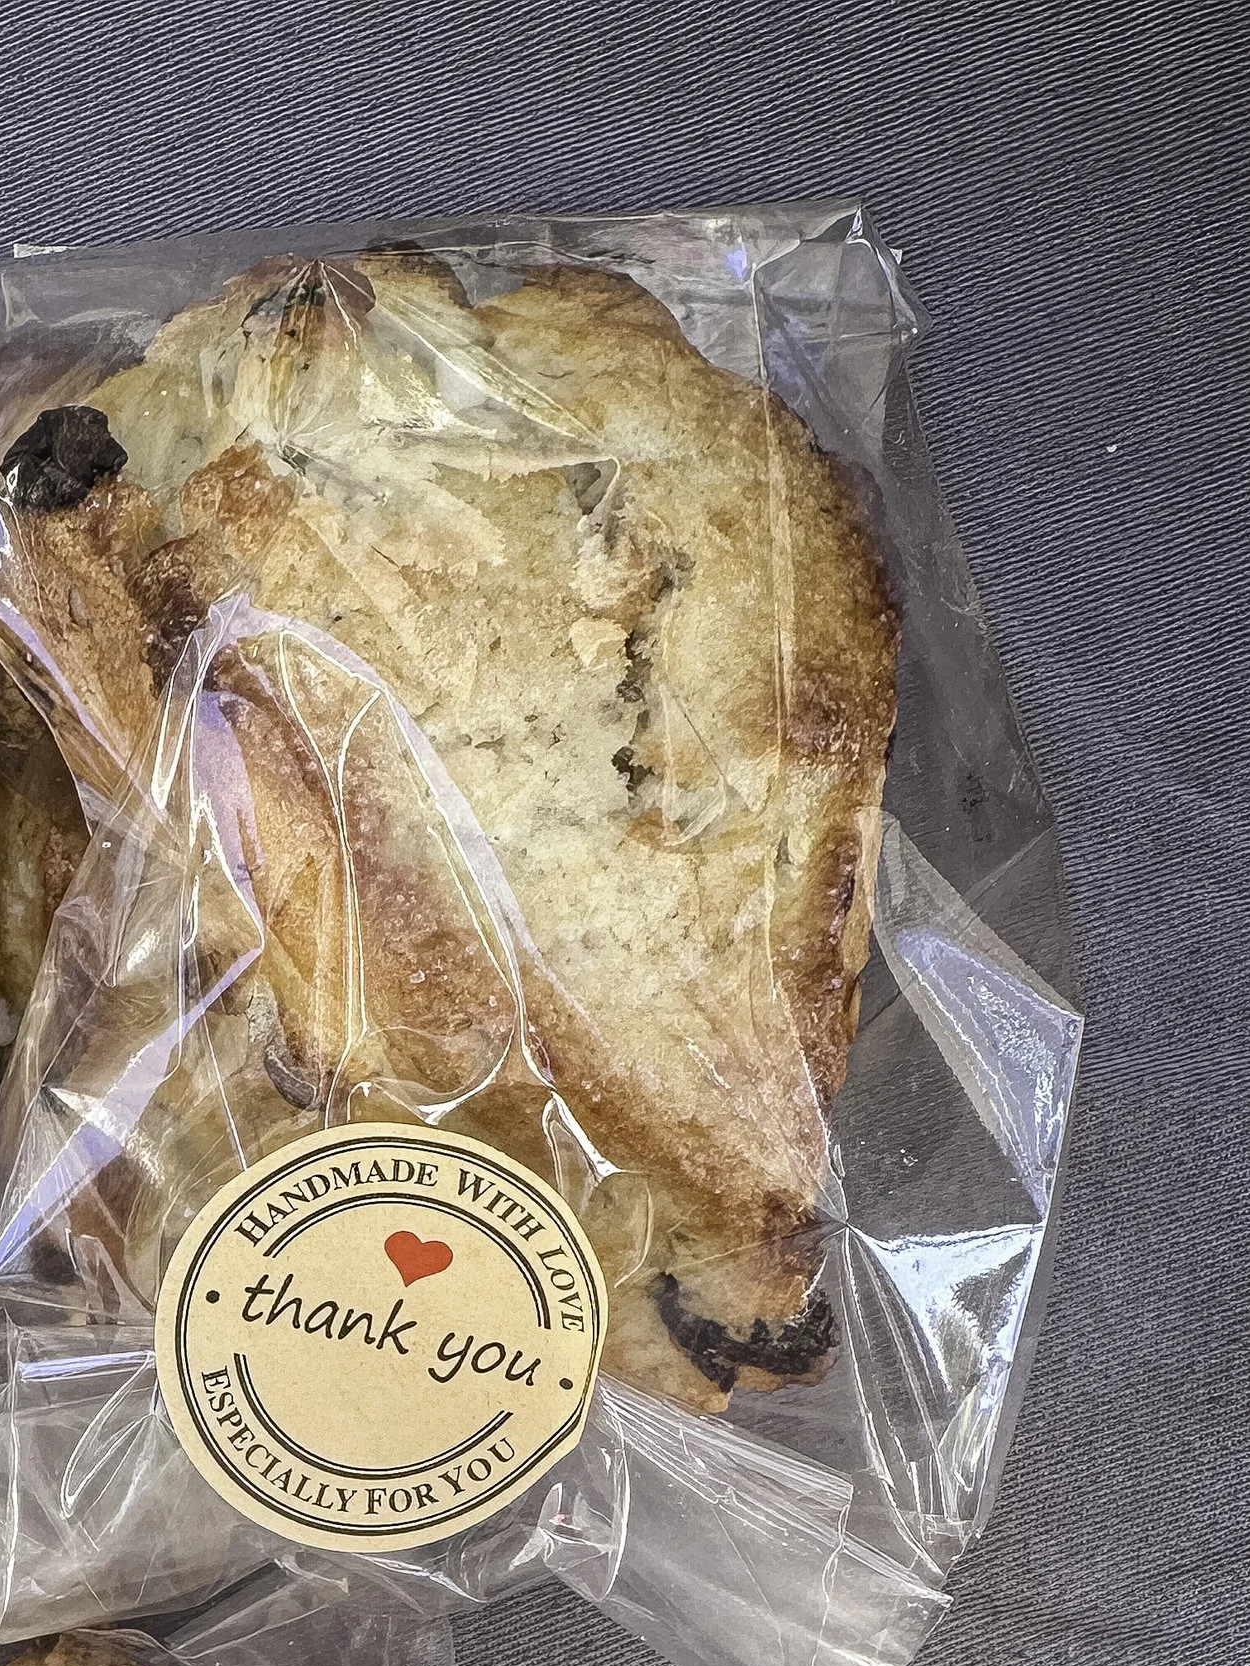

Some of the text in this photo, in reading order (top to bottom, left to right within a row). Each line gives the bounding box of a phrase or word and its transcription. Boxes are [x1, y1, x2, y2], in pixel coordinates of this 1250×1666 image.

[234, 1158, 585, 1333] HANDMADE WITH LOVE
[240, 1273, 542, 1387] thank you
[201, 1365, 516, 1515] ESPECIALLY FOR YOU
